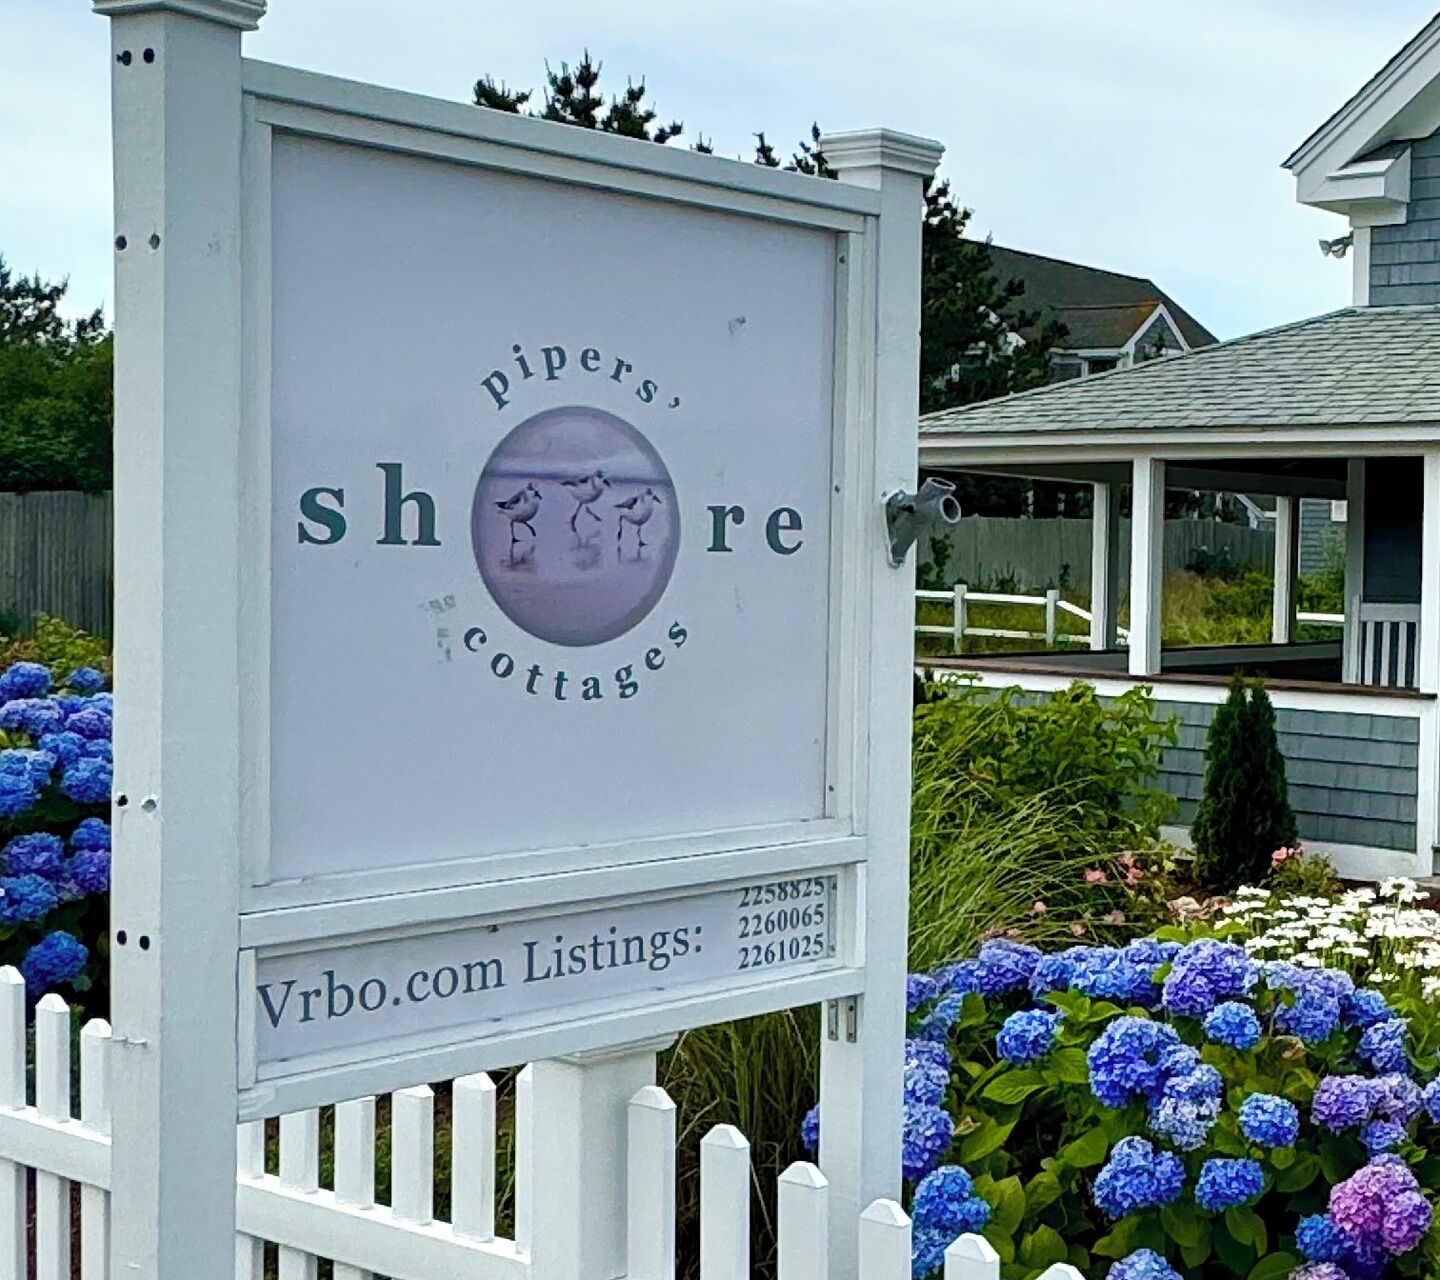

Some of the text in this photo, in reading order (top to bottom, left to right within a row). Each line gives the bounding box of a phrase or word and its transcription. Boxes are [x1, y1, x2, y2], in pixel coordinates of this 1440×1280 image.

[463, 620, 688, 701] cottages
[738, 876, 825, 908] 2258825
[738, 903, 824, 939] 2260065
[738, 932, 824, 970] 2261025
[256, 923, 703, 1030] Vrbo.com Listings:
